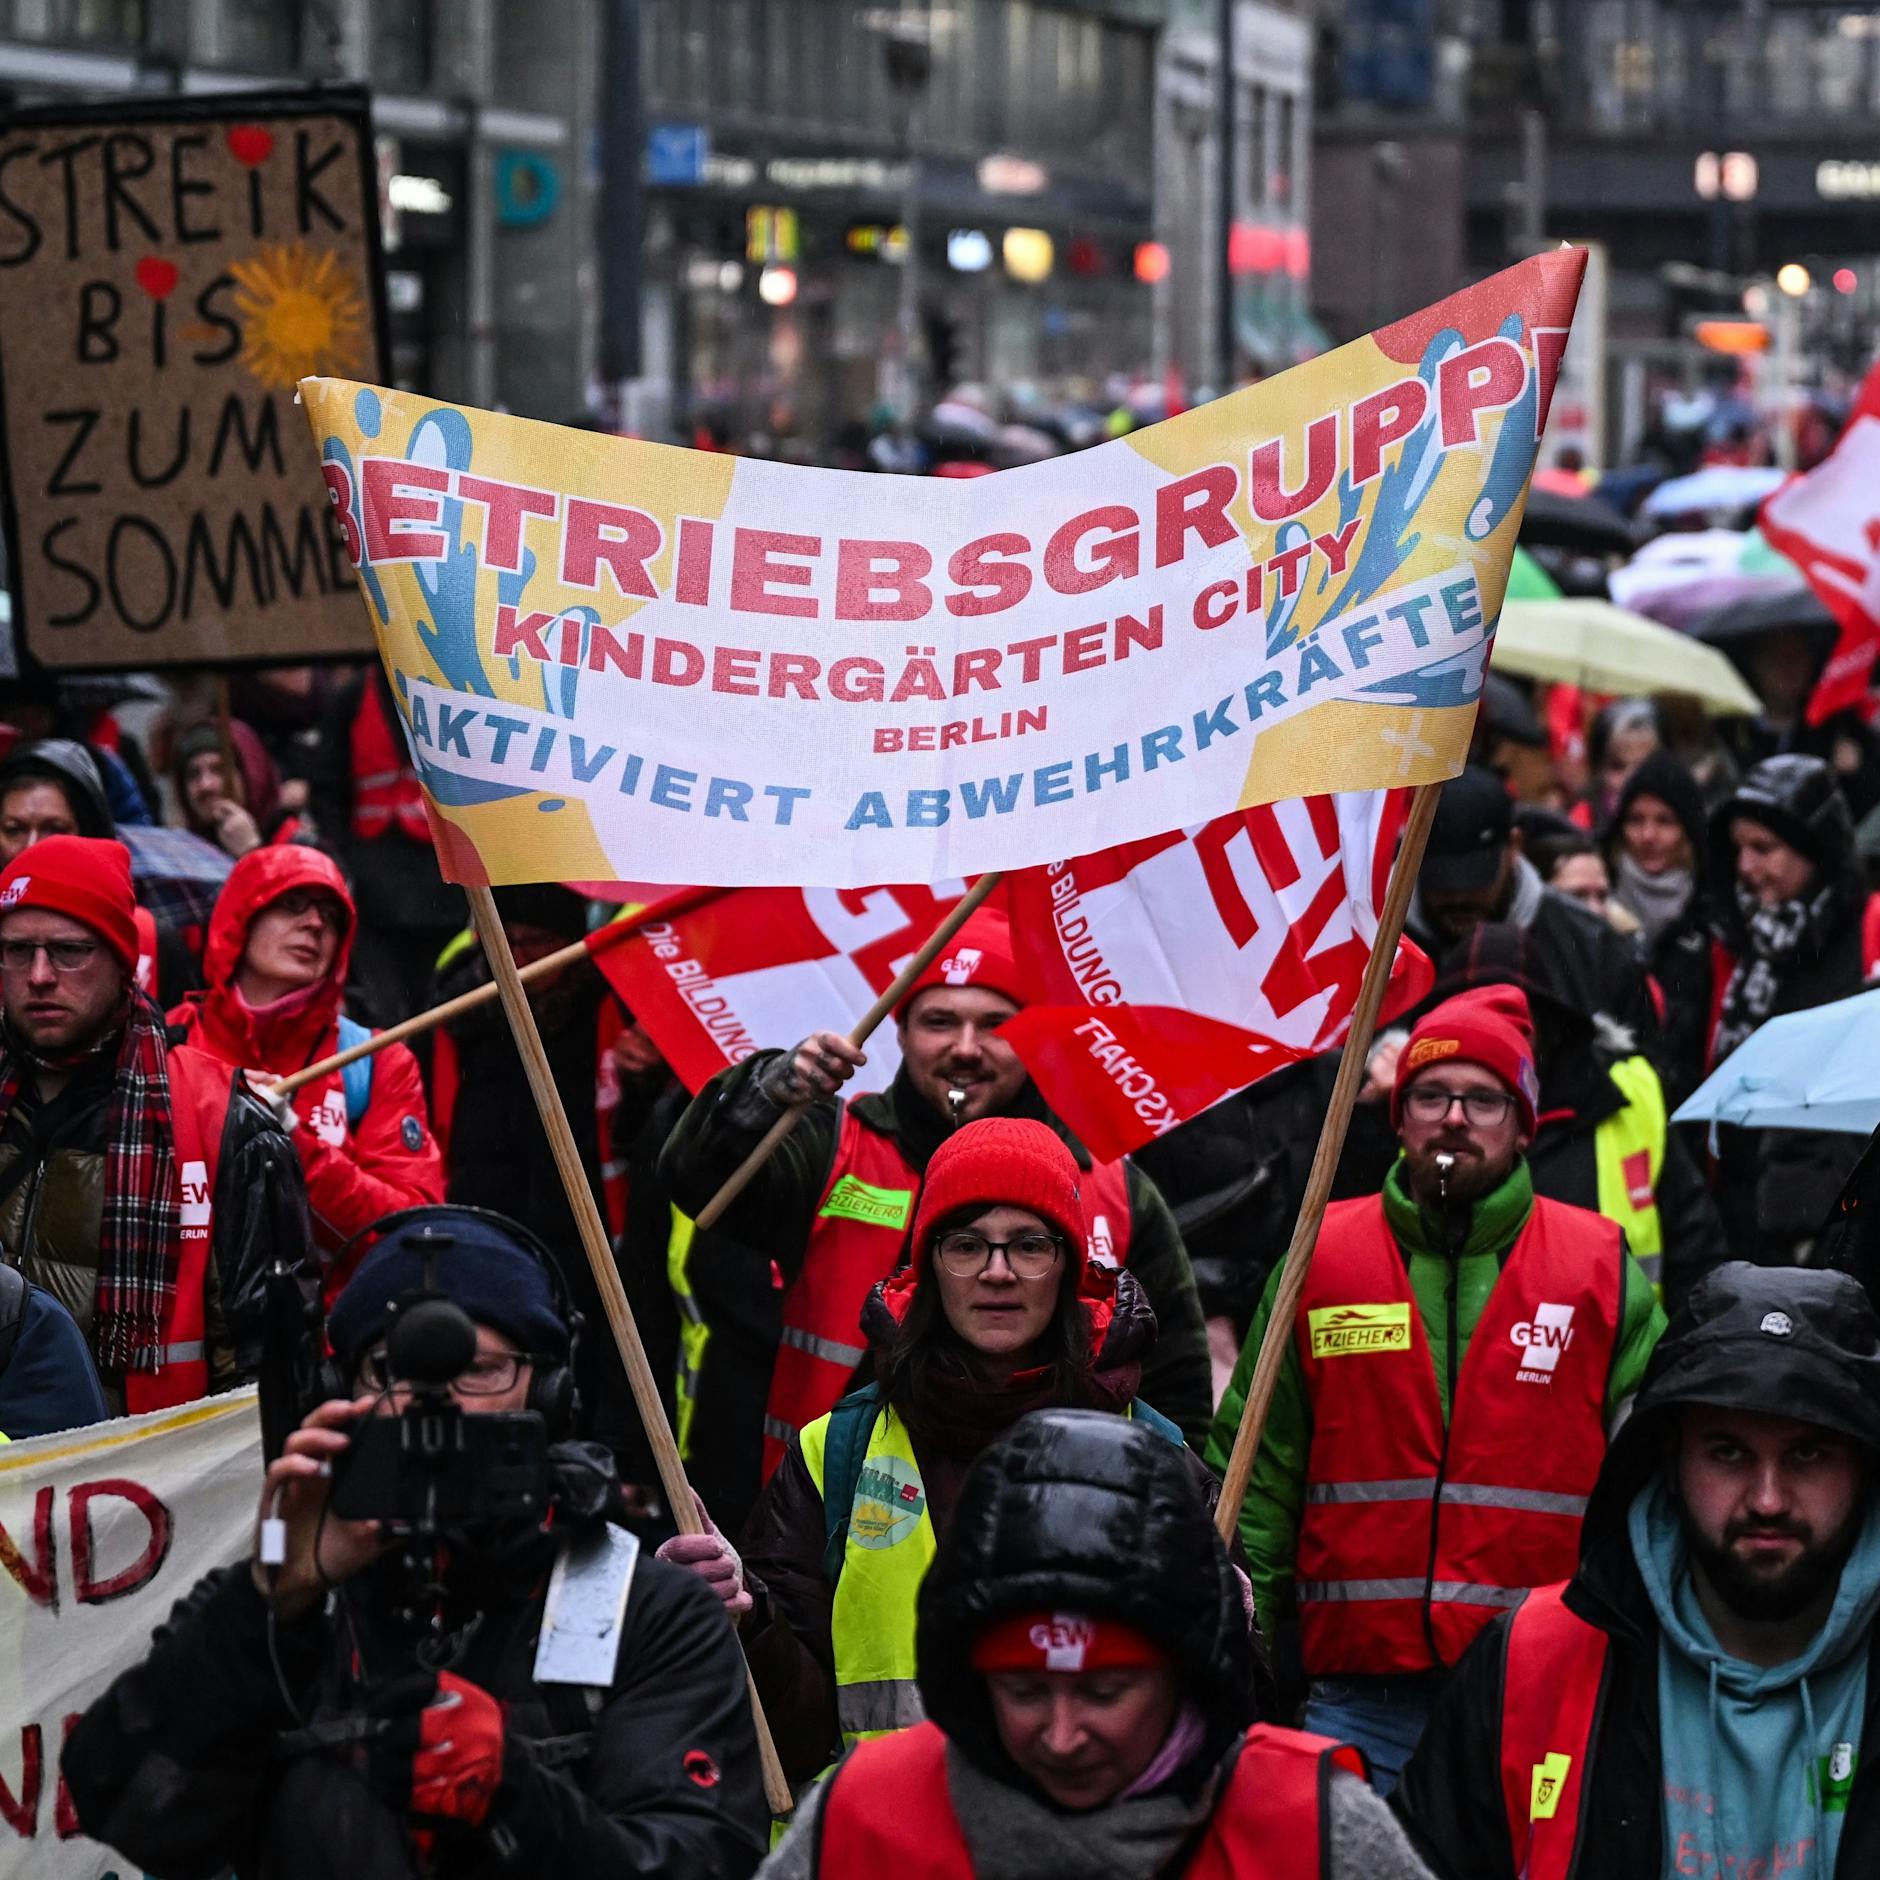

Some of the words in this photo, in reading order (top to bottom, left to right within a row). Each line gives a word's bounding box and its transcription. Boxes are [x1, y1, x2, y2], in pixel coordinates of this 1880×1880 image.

[43, 393, 287, 496] ZUM
[42, 504, 361, 633] SOMME
[493, 604, 1164, 703] KINDERGÄRTEN
[1192, 518, 1364, 631] CITY
[410, 695, 812, 827] AKTIVIERT
[843, 577, 1483, 831] ABWEHRKRÄFTE
[873, 705, 1048, 753] BERLIN
[640, 921, 681, 959] Die
[180, 1228, 209, 1240] ERLIN
[1509, 1321, 1574, 1351] GEW
[1516, 1370, 1552, 1385] BERLIN
[1029, 1622, 1096, 1650] GEW
